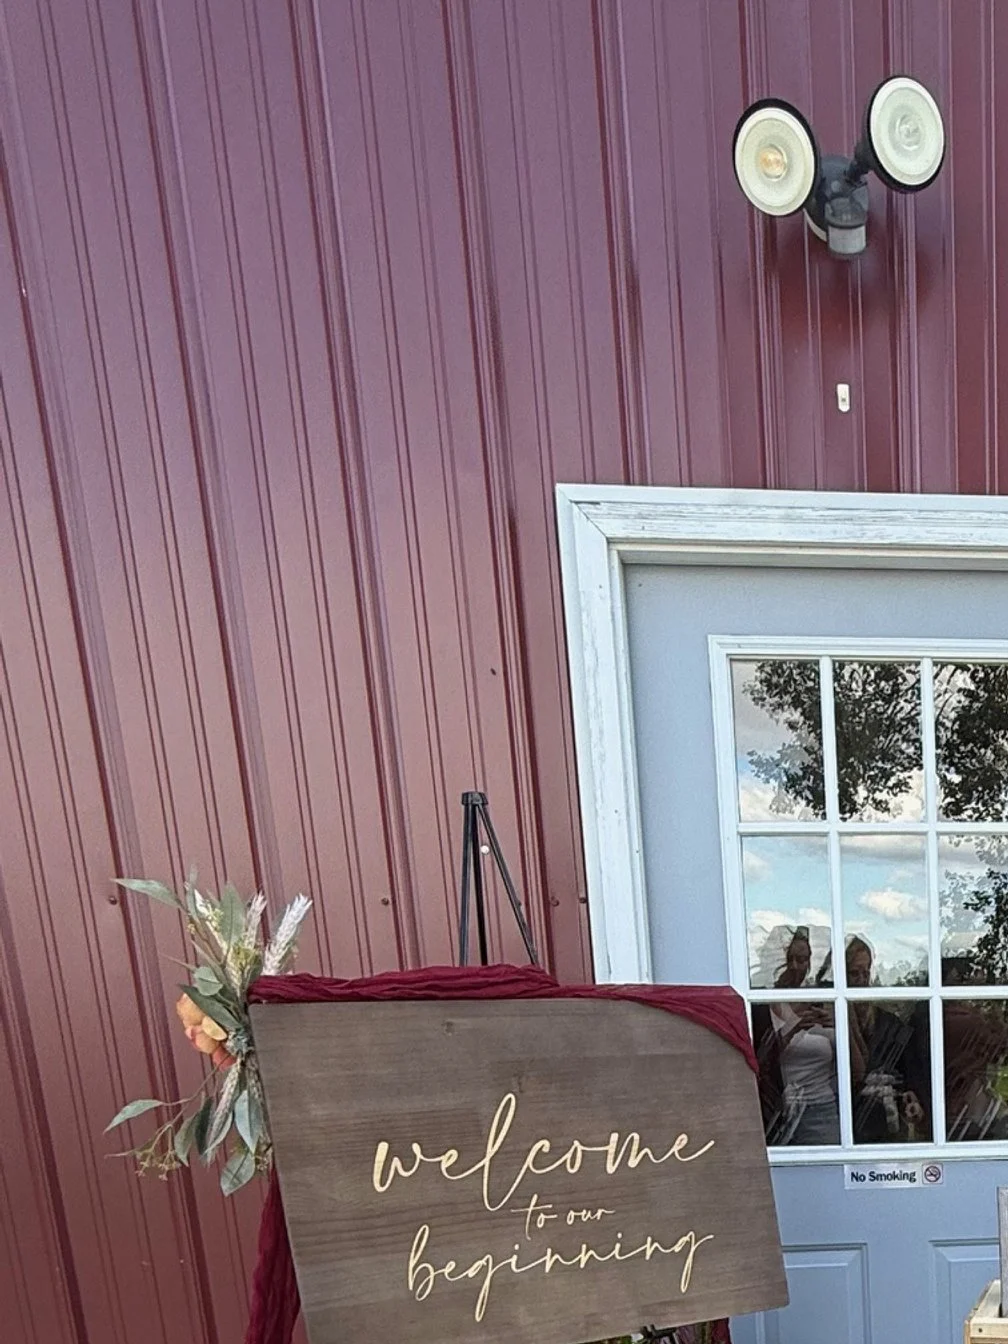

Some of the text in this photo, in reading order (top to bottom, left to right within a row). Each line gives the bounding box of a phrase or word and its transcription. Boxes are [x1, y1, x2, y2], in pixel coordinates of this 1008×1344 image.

[372, 1093, 714, 1211] welcome
[850, 1170, 917, 1183] No Smoking
[511, 1194, 615, 1240] to our
[408, 1224, 714, 1322] beginning
